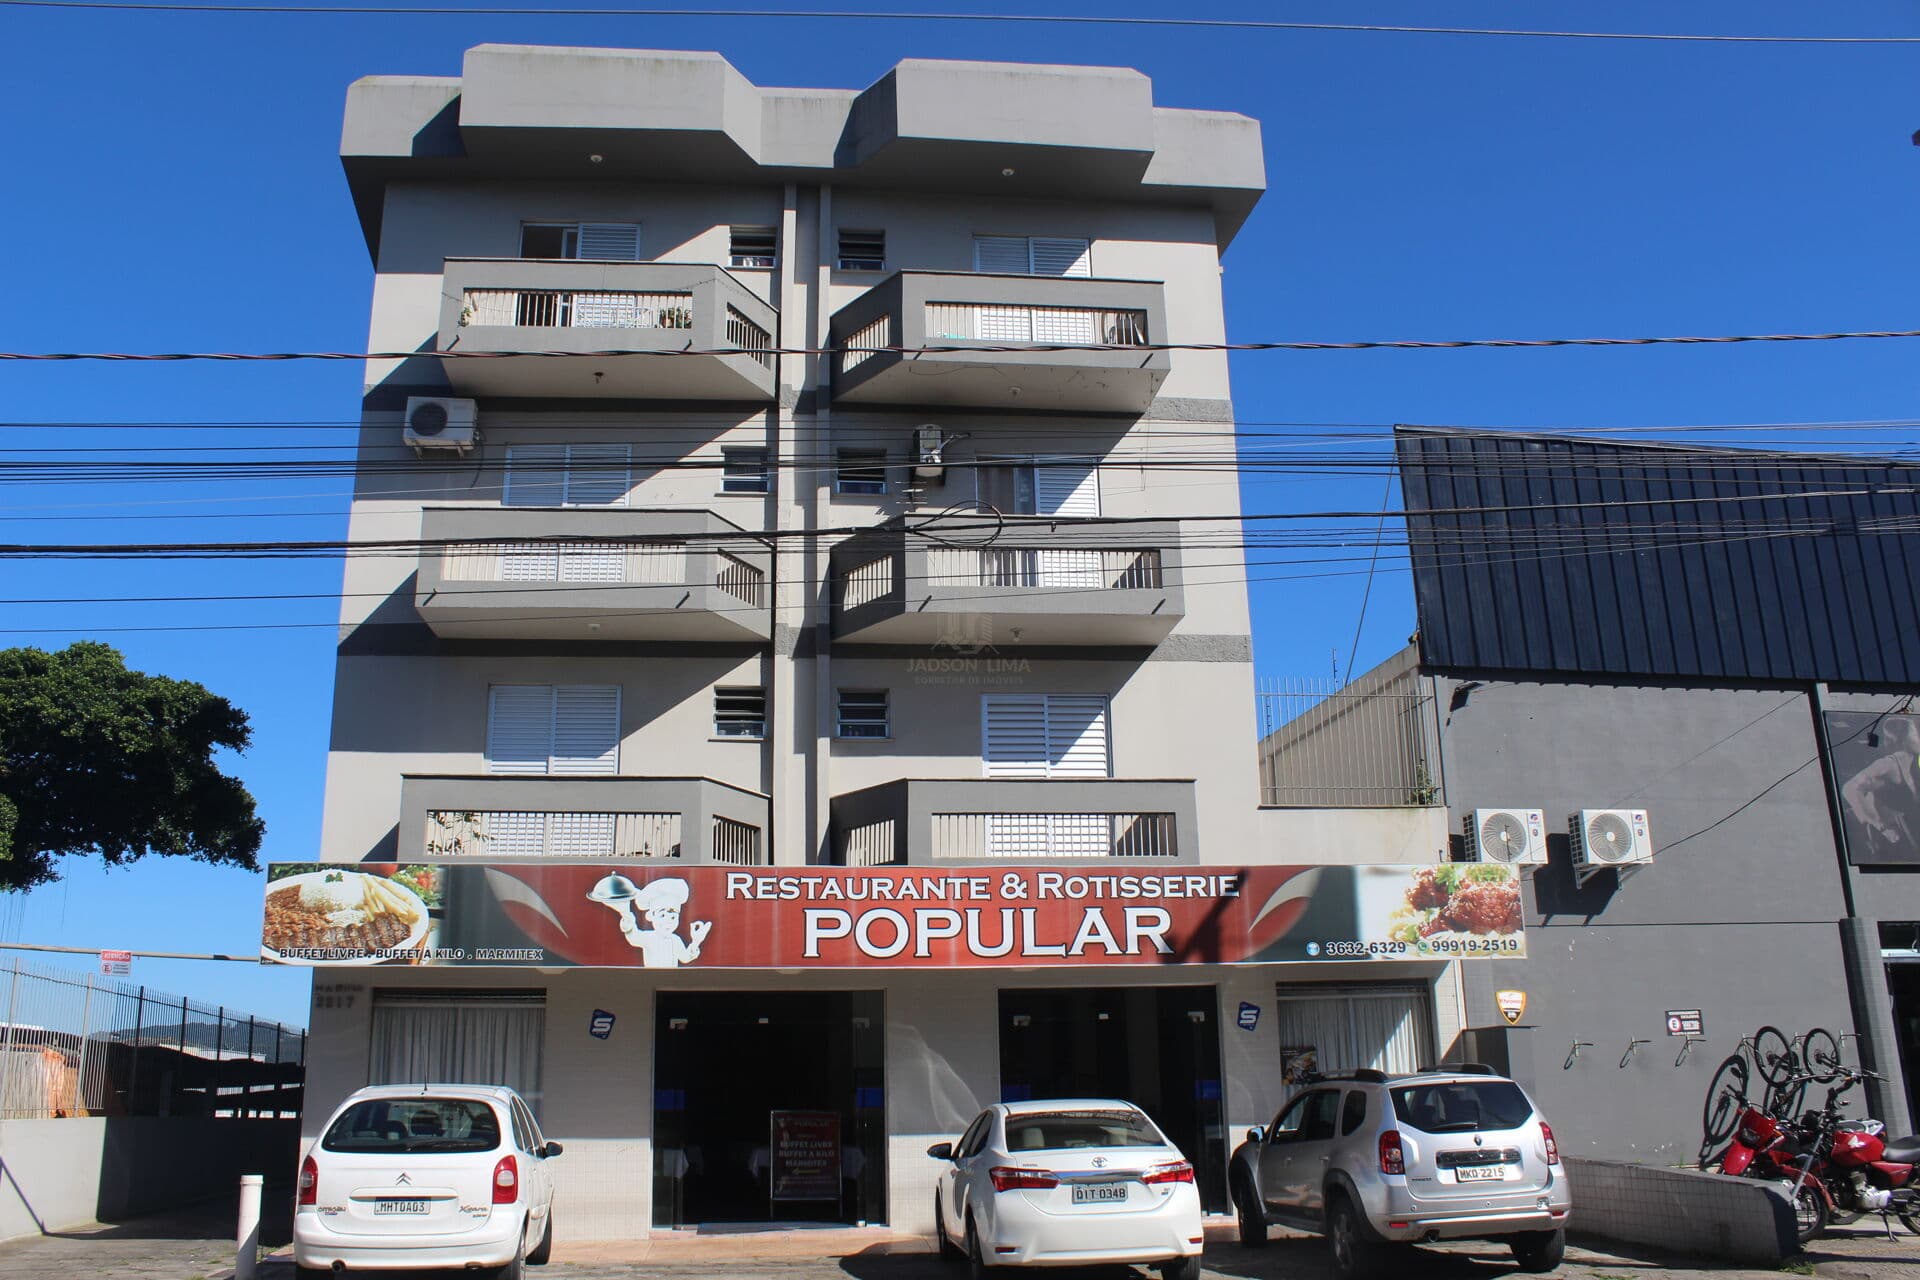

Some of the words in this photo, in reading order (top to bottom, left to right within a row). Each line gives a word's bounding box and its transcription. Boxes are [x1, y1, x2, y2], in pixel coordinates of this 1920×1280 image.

[726, 872, 992, 900] RESTAURANTE
[1001, 873, 1027, 899] &
[1038, 872, 1240, 899] ROTISSERIE
[803, 906, 1175, 958] POPULAR
[280, 948, 325, 958] BUFFET
[328, 948, 363, 958] LIVRE
[376, 948, 420, 959] BUFFET
[436, 948, 464, 959] KILO
[476, 948, 543, 960] MARMITEX
[1327, 942, 1406, 956] 3632-6329
[1431, 939, 1518, 952] 99919-2519
